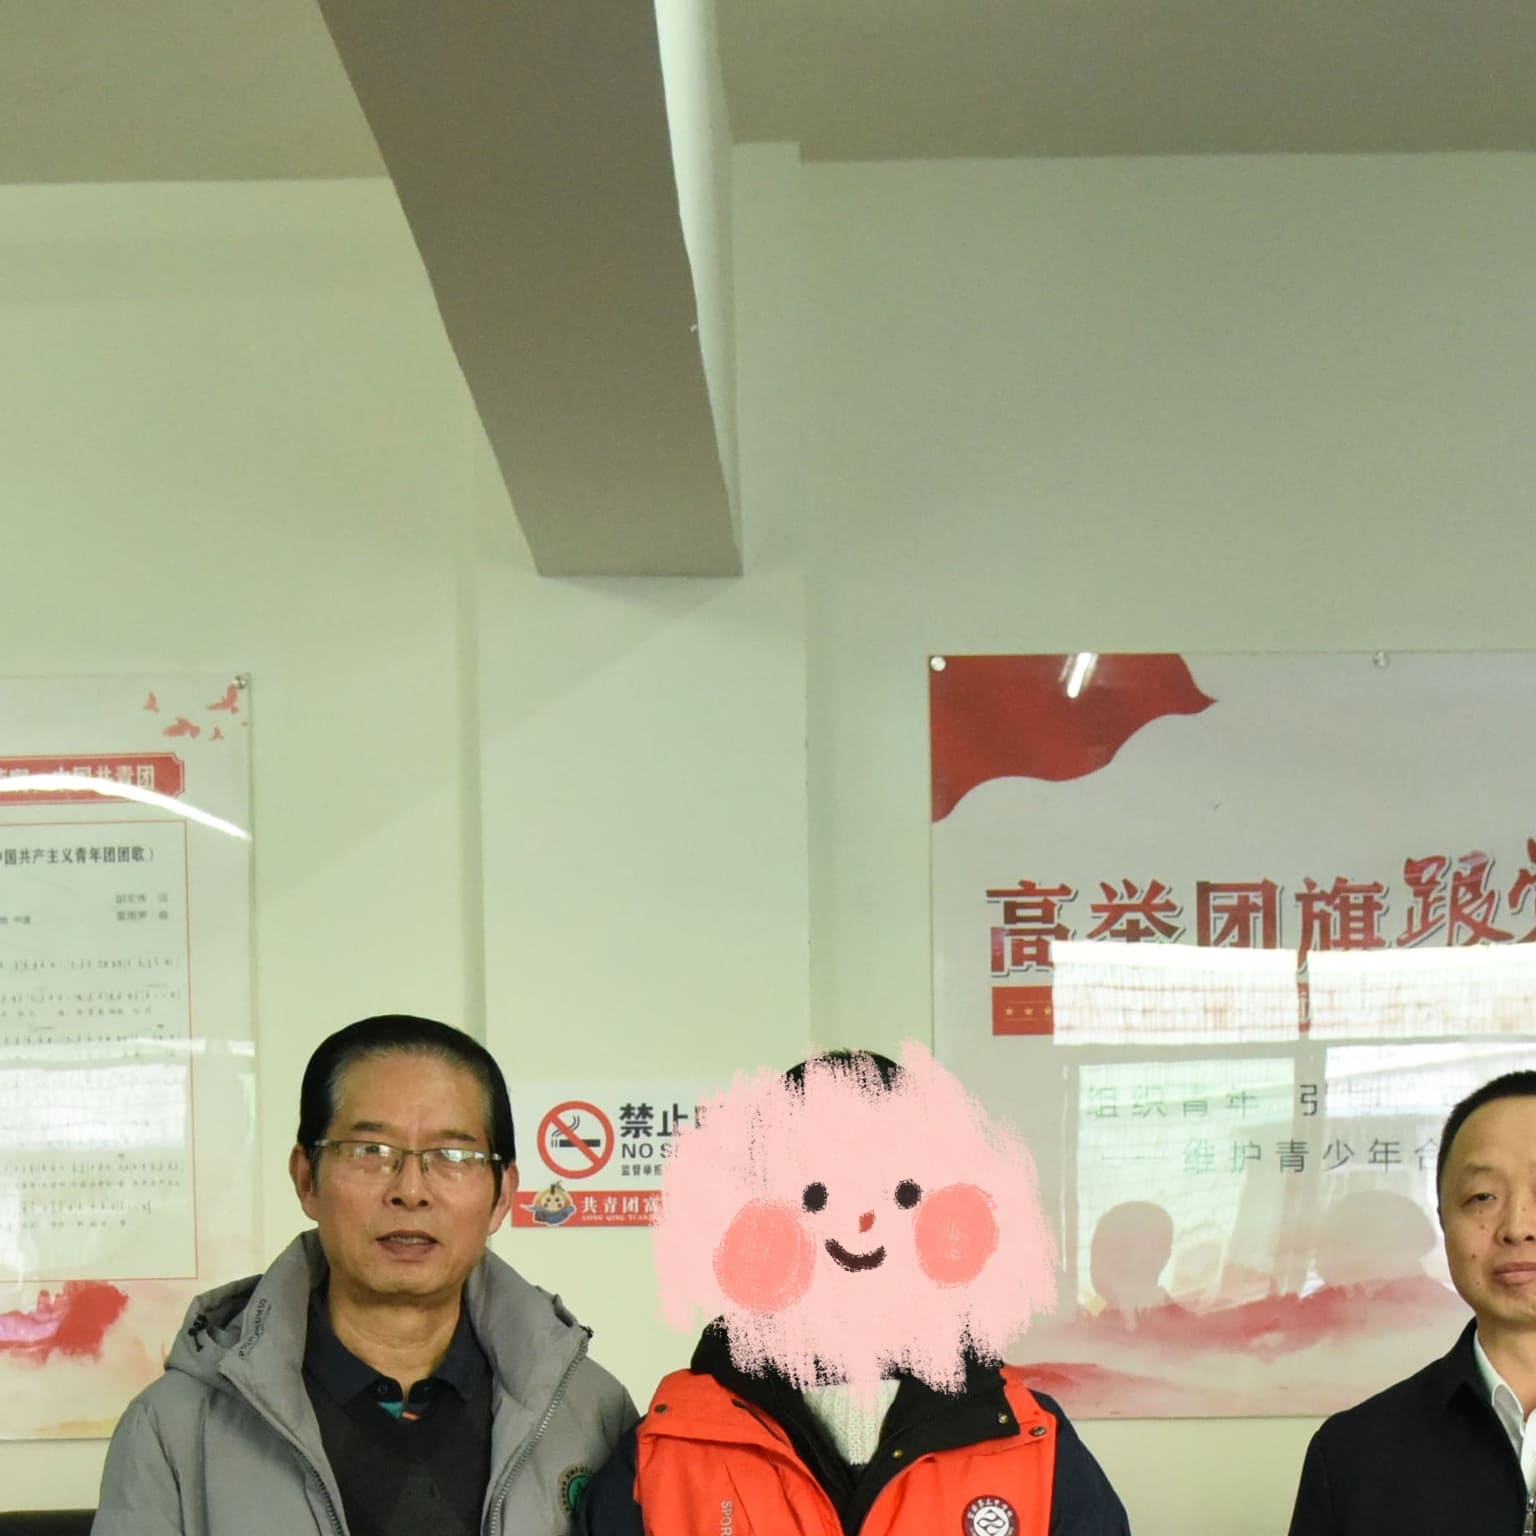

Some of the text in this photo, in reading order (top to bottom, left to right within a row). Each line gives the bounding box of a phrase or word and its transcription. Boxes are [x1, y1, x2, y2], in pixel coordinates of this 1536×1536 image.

[1087, 1082, 1258, 1120] 组织青年
[619, 1103, 707, 1138] 禁止
[622, 1144, 653, 1159] NO
[1184, 1138, 1438, 1175] 维护青少年合
